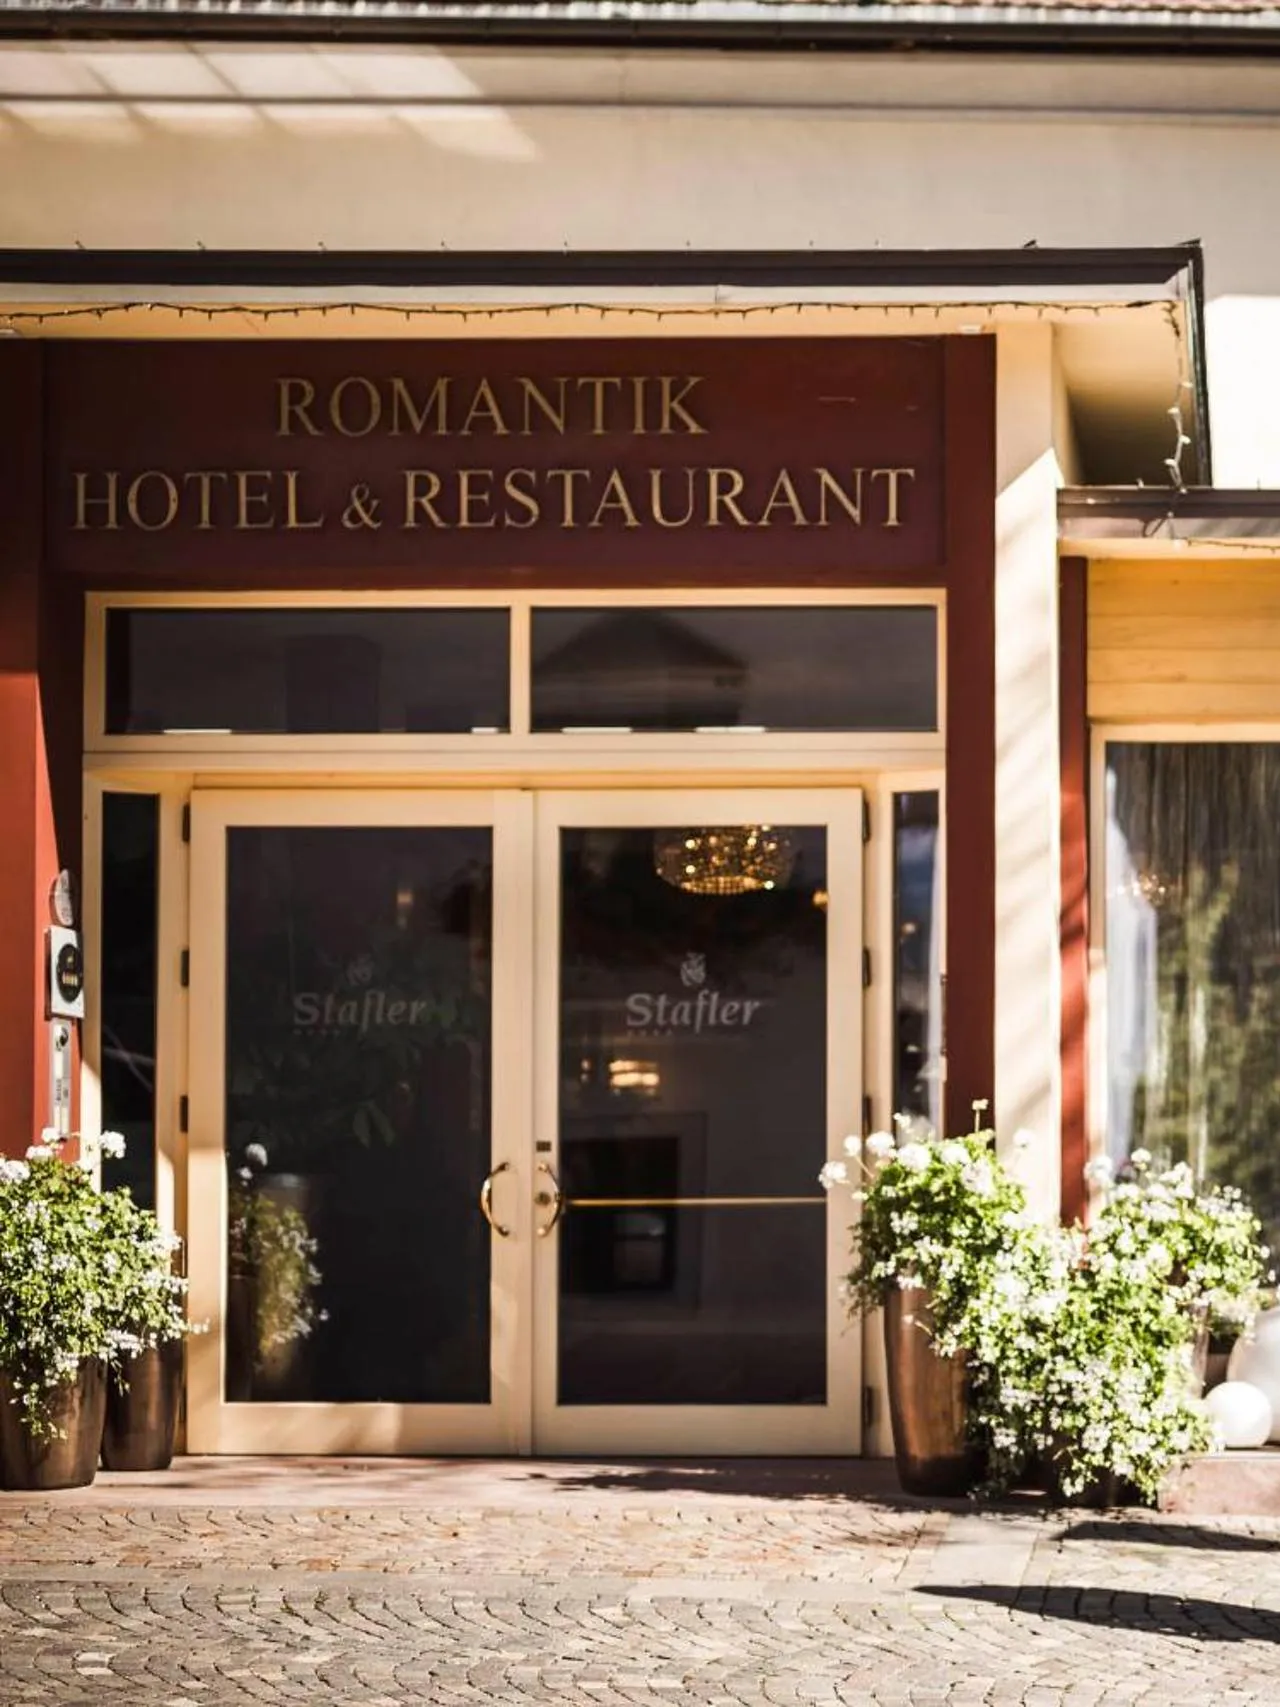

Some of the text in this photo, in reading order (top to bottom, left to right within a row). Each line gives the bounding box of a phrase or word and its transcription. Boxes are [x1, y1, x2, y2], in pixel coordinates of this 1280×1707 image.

[275, 376, 709, 437] ROMANTIK
[71, 468, 915, 531] HOTEL & RESTAURANT
[292, 989, 427, 1034] Stafler
[626, 989, 760, 1032] Stafler
